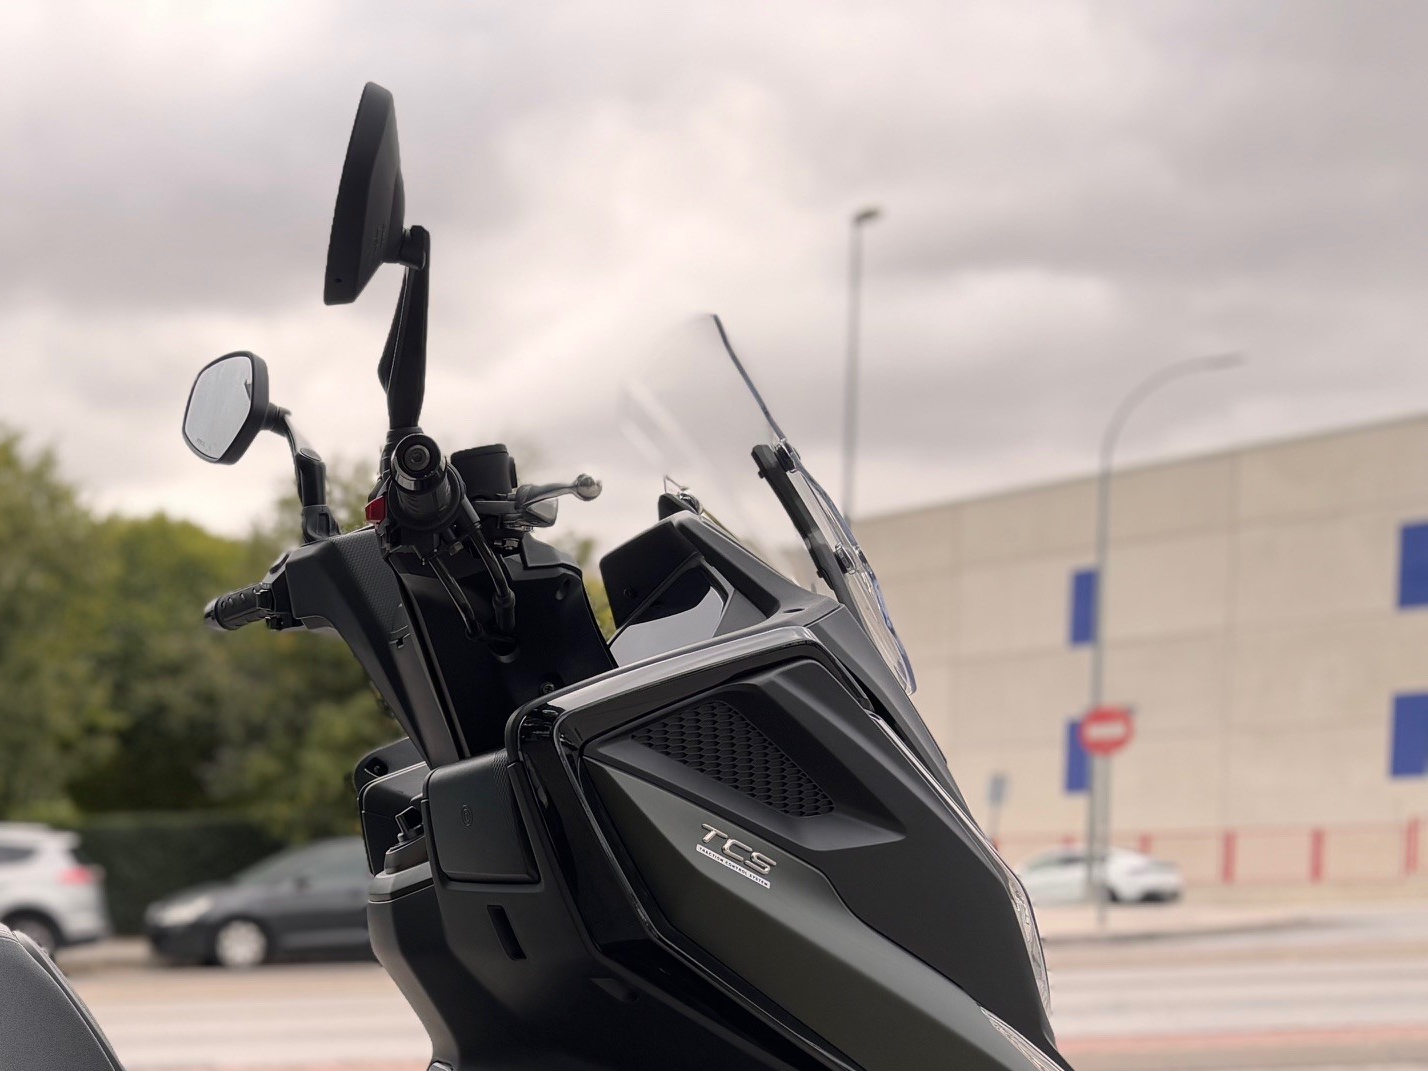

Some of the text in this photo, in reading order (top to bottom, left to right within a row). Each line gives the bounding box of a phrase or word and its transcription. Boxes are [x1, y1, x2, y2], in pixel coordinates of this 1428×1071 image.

[699, 847, 768, 887] TRACTION CONTROL SYSTEM
[701, 823, 777, 875] TCS
